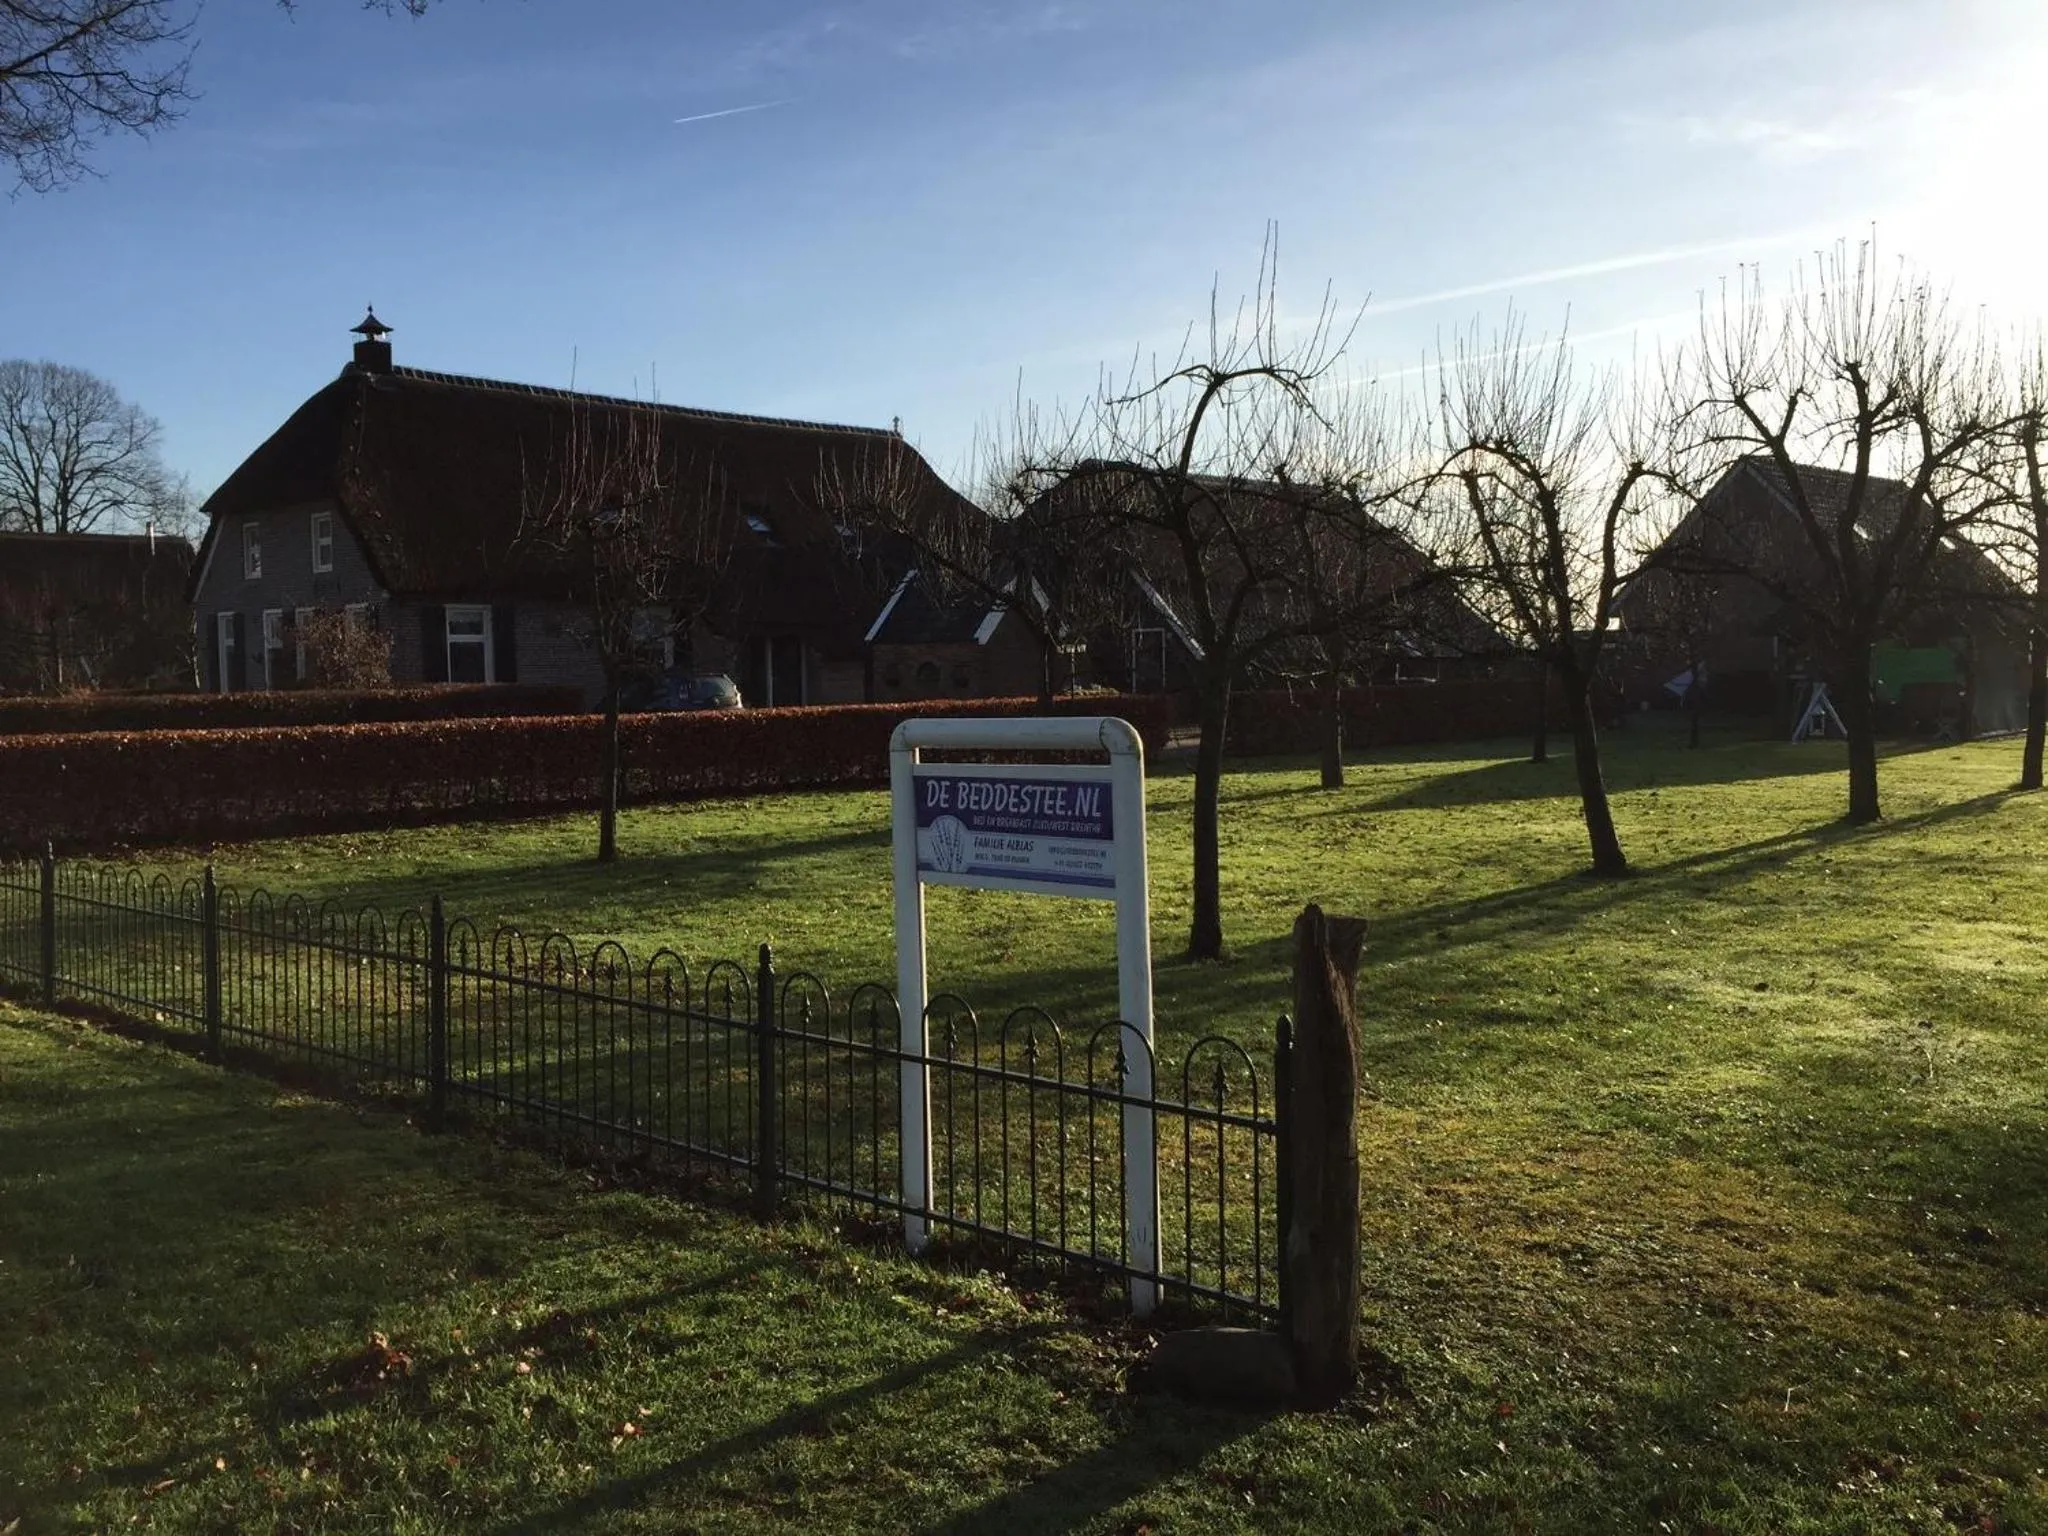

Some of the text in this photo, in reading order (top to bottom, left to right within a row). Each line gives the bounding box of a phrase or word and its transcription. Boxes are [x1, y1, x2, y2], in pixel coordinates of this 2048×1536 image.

[926, 779, 1101, 817] DE BEDDESTEE.NL
[974, 836, 1004, 851] FAMILIE
